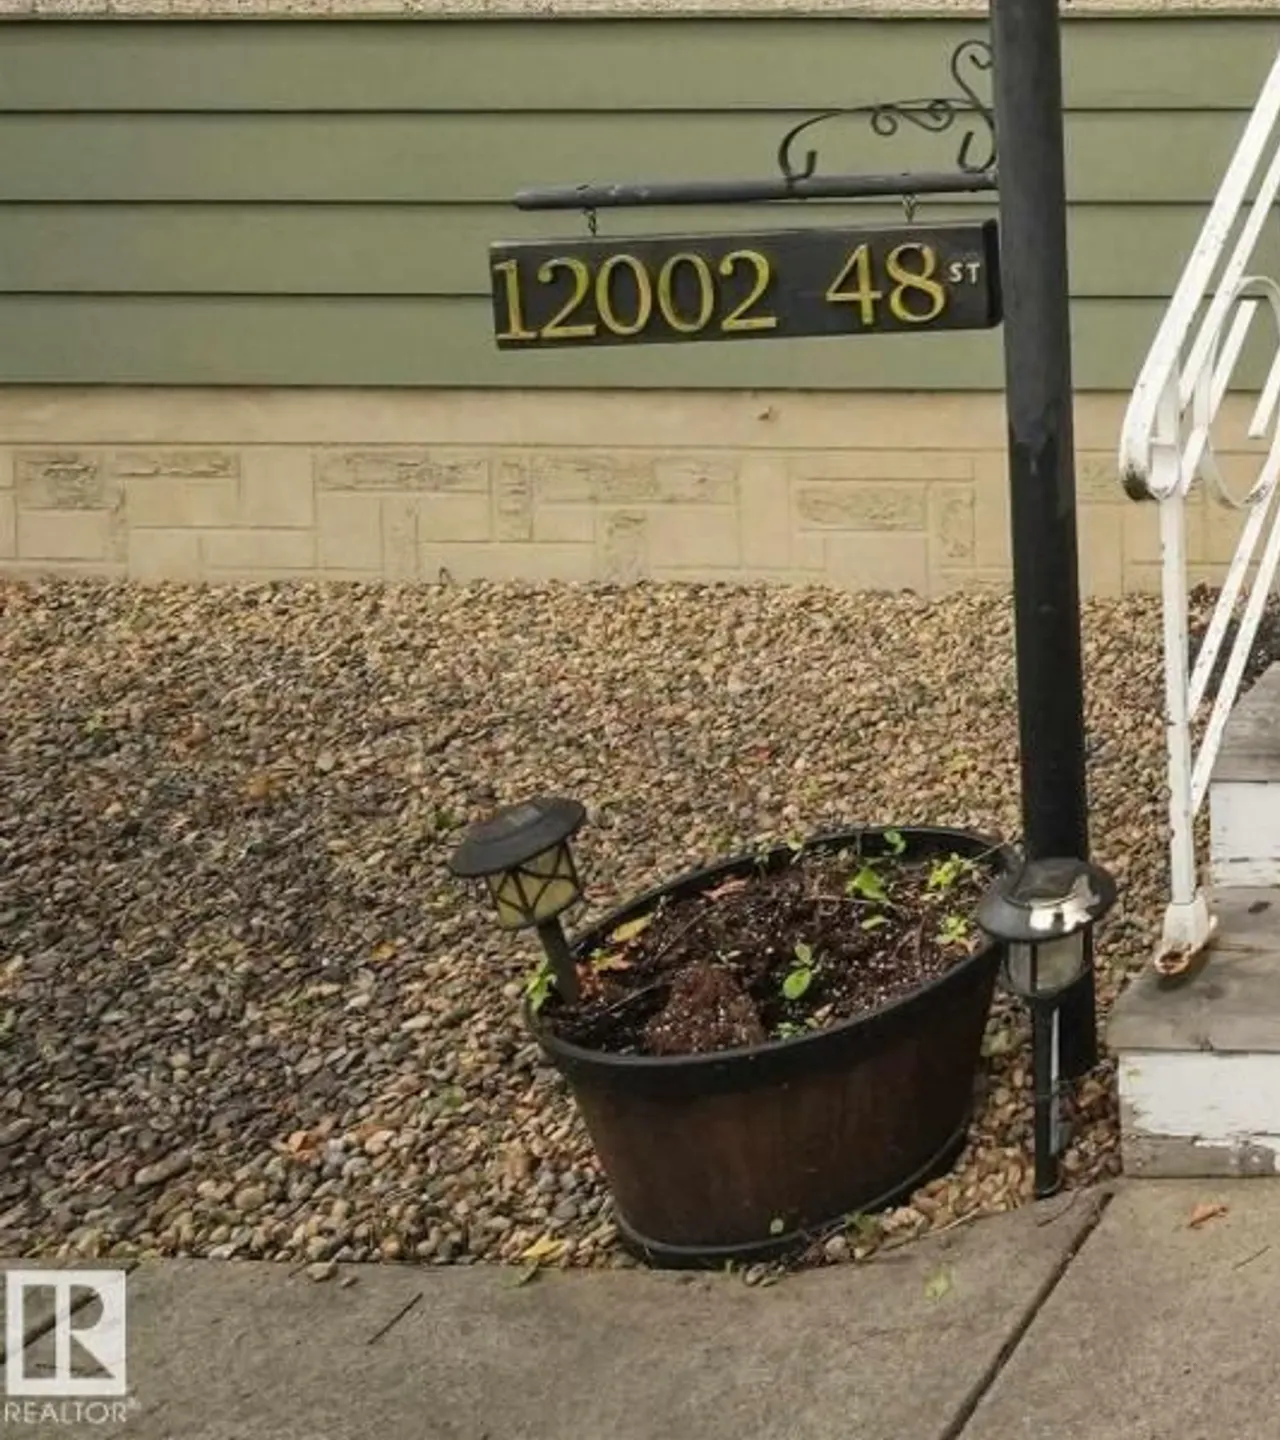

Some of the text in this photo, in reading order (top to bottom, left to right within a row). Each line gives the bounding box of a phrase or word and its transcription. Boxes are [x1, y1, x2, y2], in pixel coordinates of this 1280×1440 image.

[494, 242, 981, 341] 12002 48 ST
